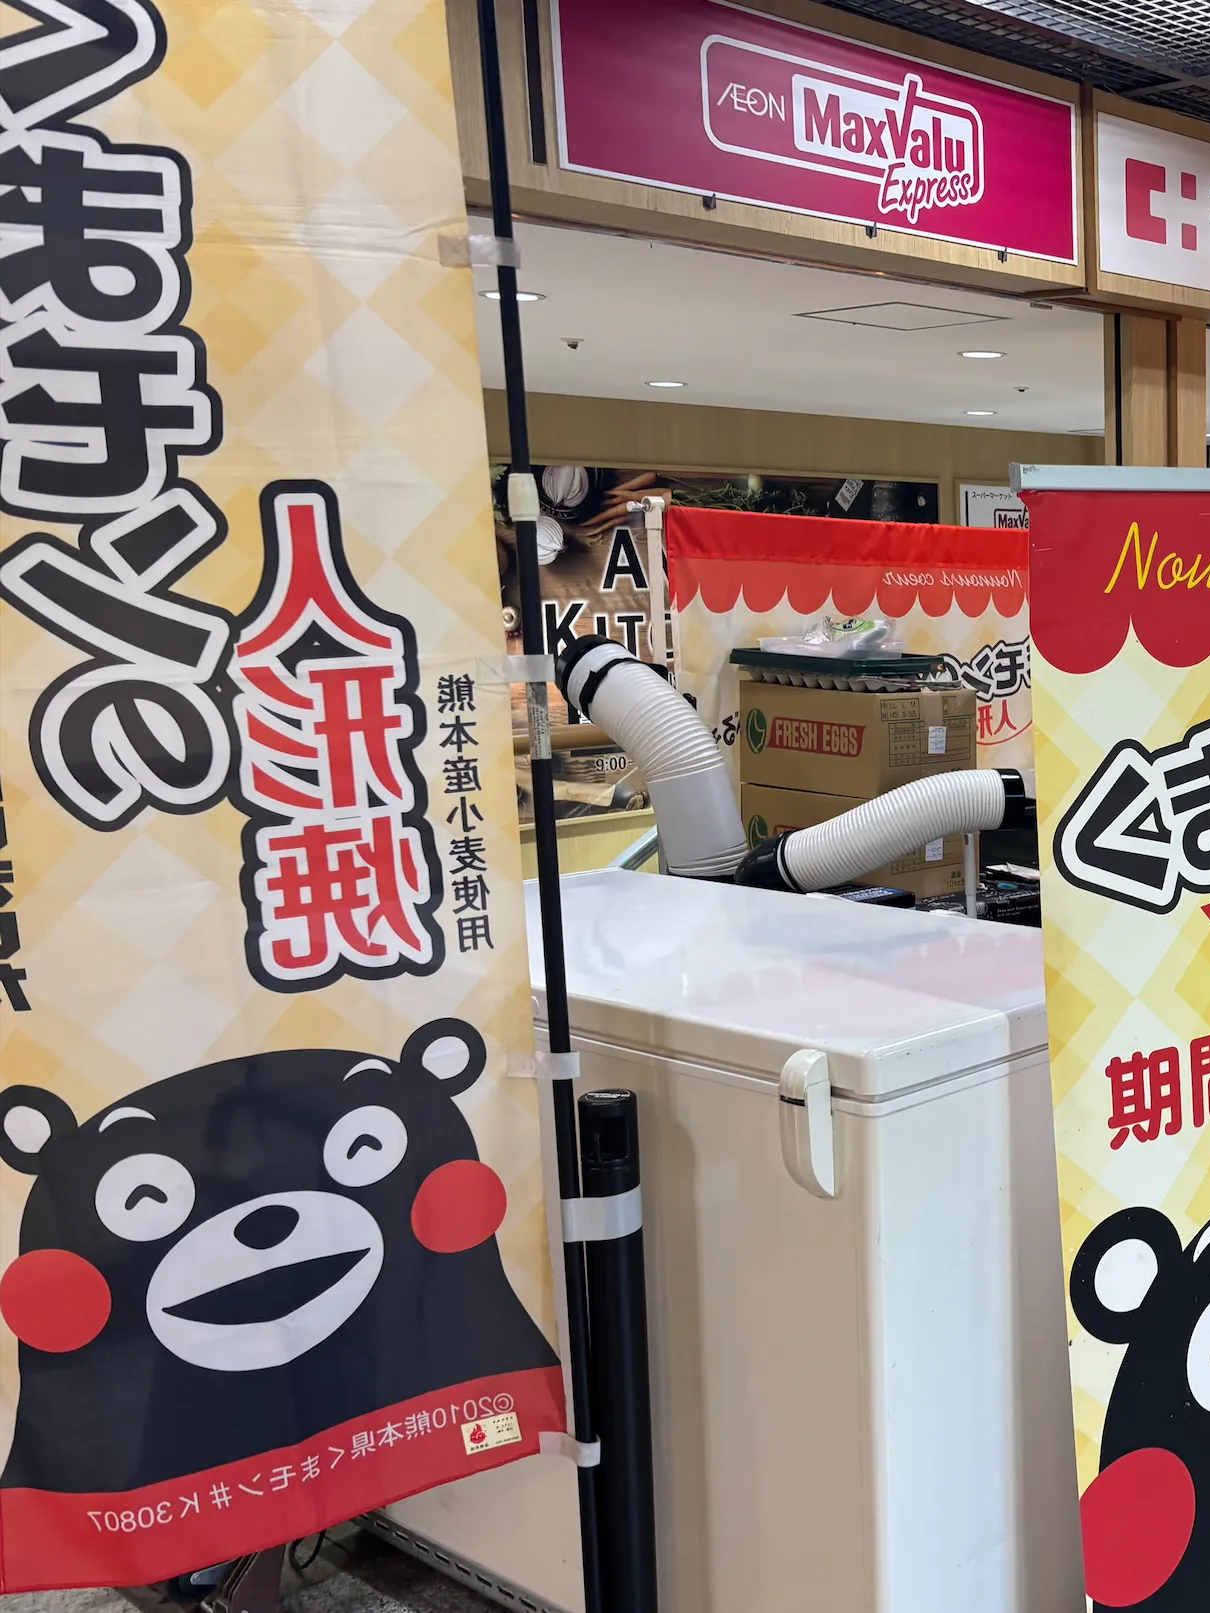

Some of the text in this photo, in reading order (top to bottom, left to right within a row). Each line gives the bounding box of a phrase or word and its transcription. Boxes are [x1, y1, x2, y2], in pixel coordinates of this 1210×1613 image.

[802, 80, 966, 173] MaxValu
[882, 161, 973, 220] Express
[971, 491, 1013, 500] スーパーマーケット
[774, 719, 818, 750] FRESH
[822, 724, 859, 755] EGGS
